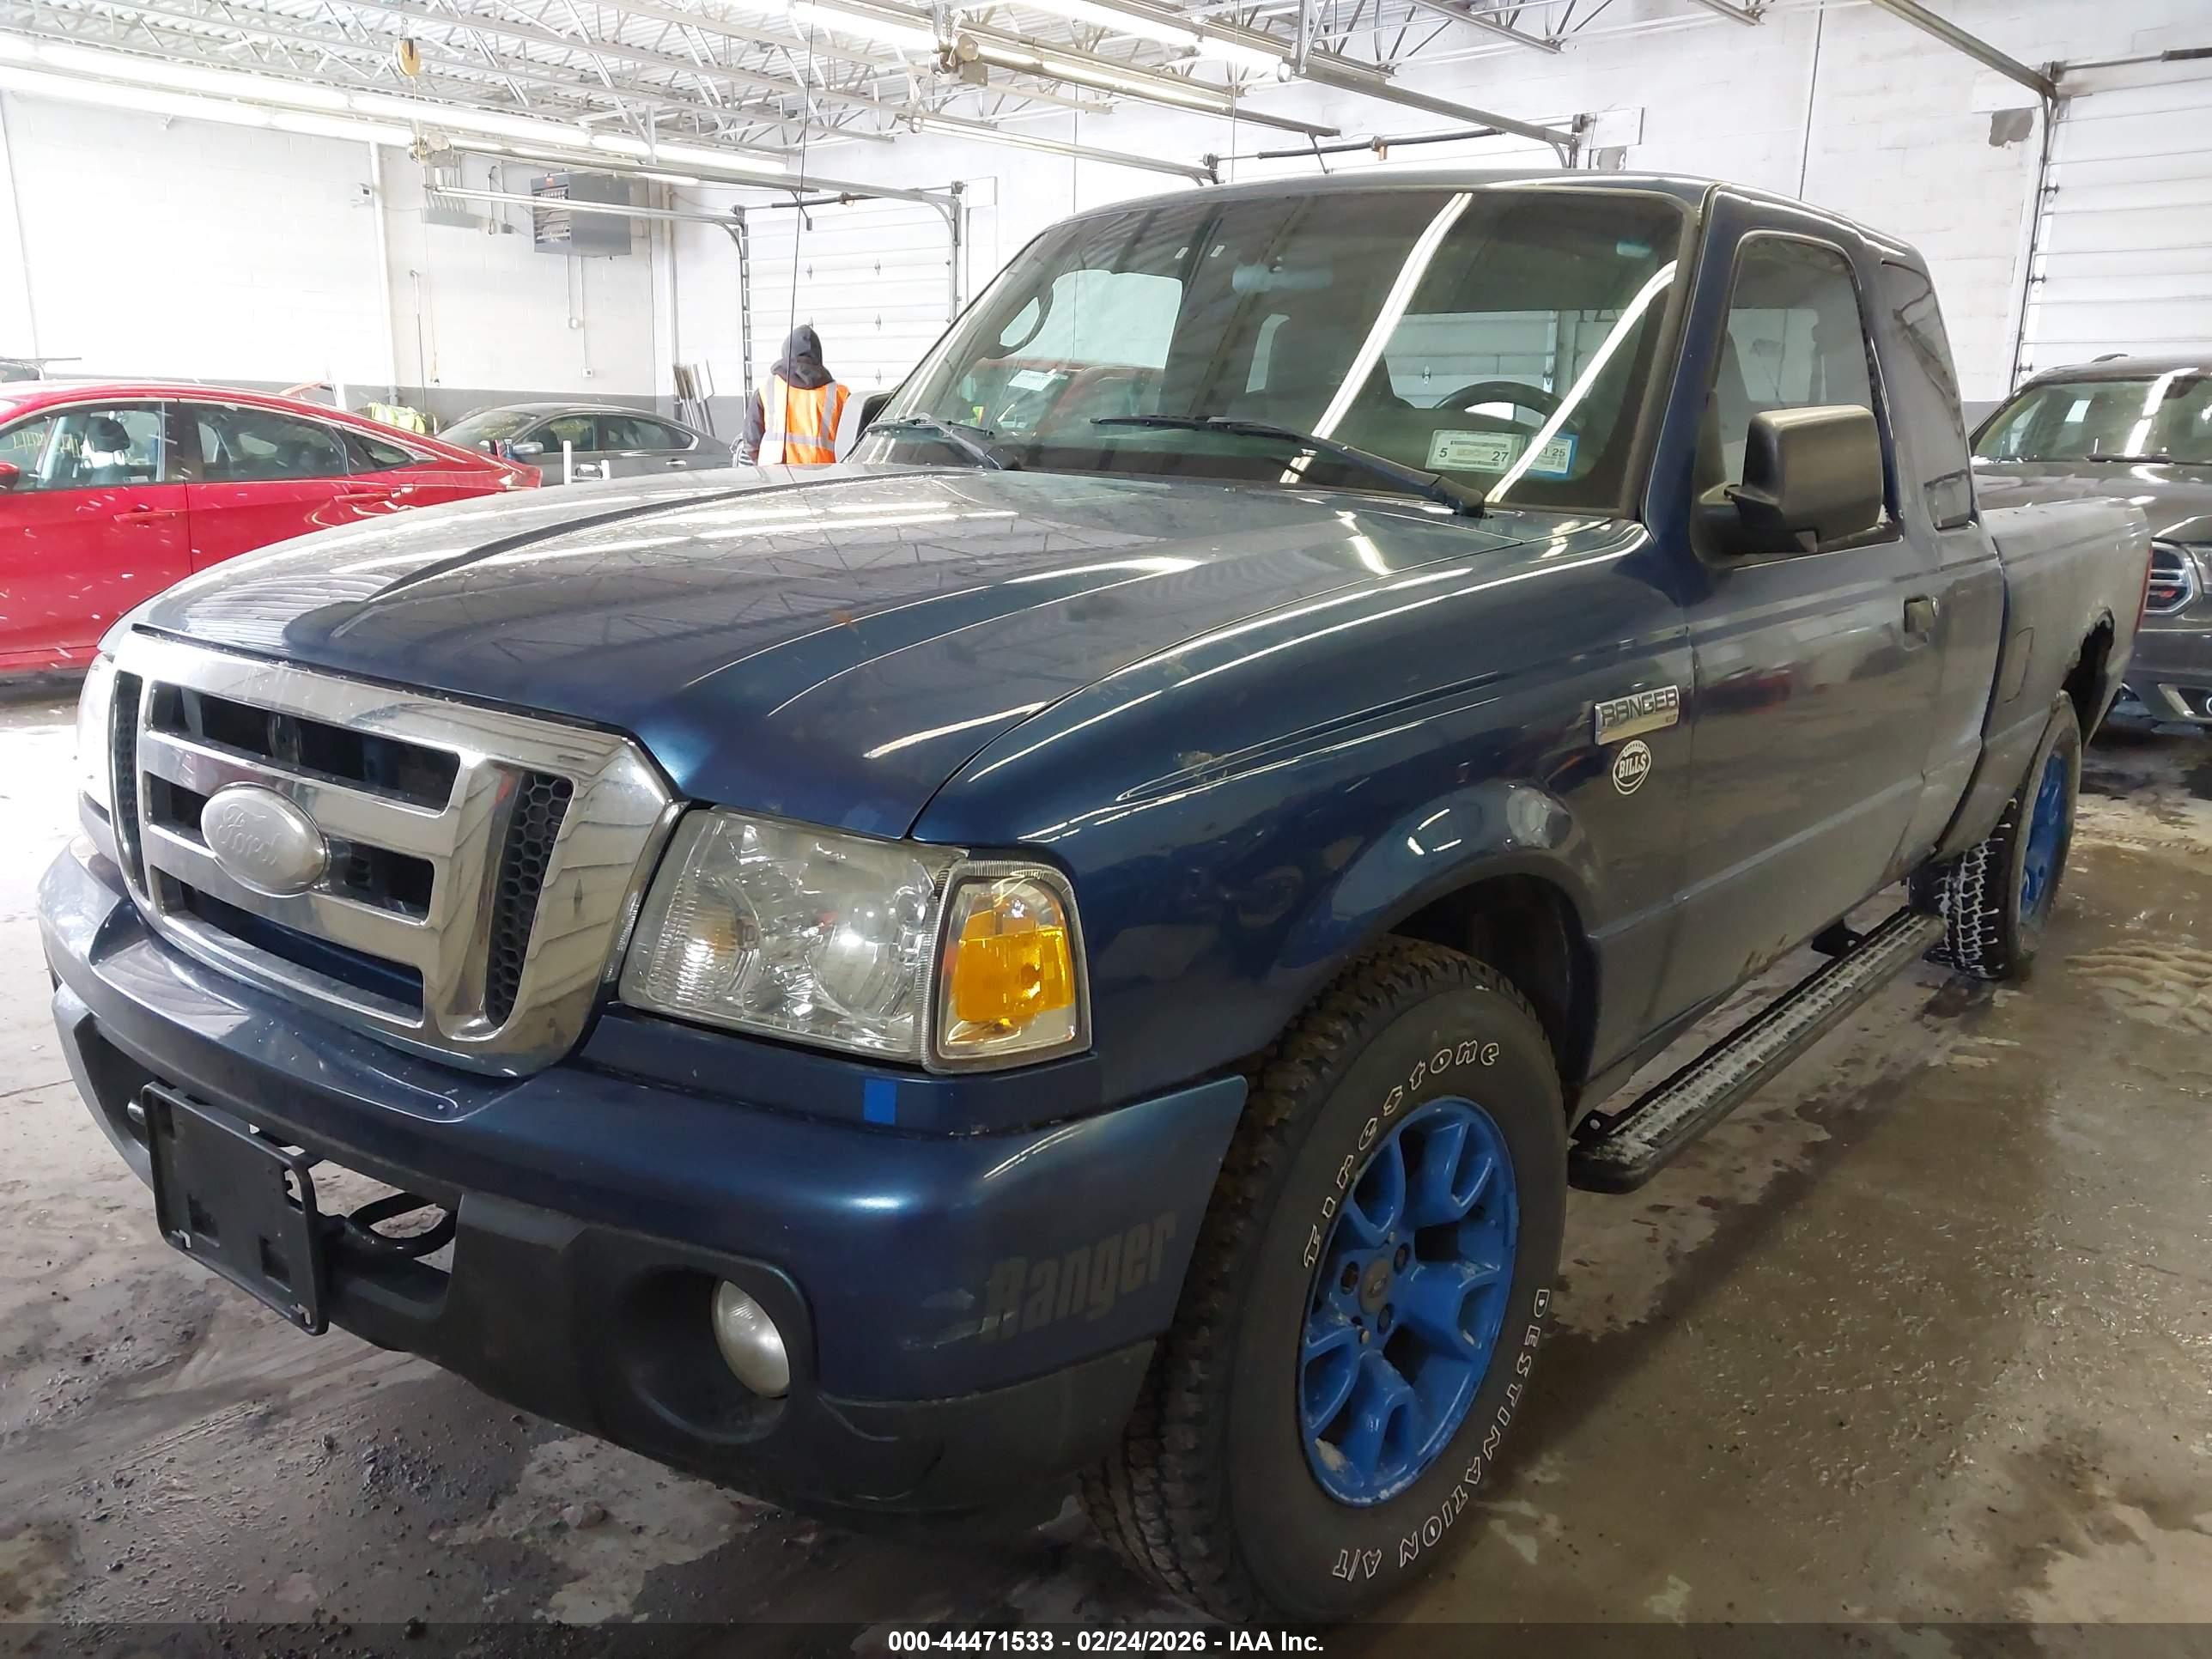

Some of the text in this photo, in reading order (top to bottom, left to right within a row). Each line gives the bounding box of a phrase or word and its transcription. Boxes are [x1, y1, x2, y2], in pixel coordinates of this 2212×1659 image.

[1439, 447, 1448, 458] 5
[1492, 451, 1509, 462] 27
[1552, 447, 1565, 458] 25
[1601, 688, 1678, 727] RANGER
[1619, 754, 1647, 779] BILLS
[216, 803, 282, 866] Ford
[980, 1210, 1177, 1344] Ranger
[1333, 1289, 1550, 1582] DESTINATION A/T
